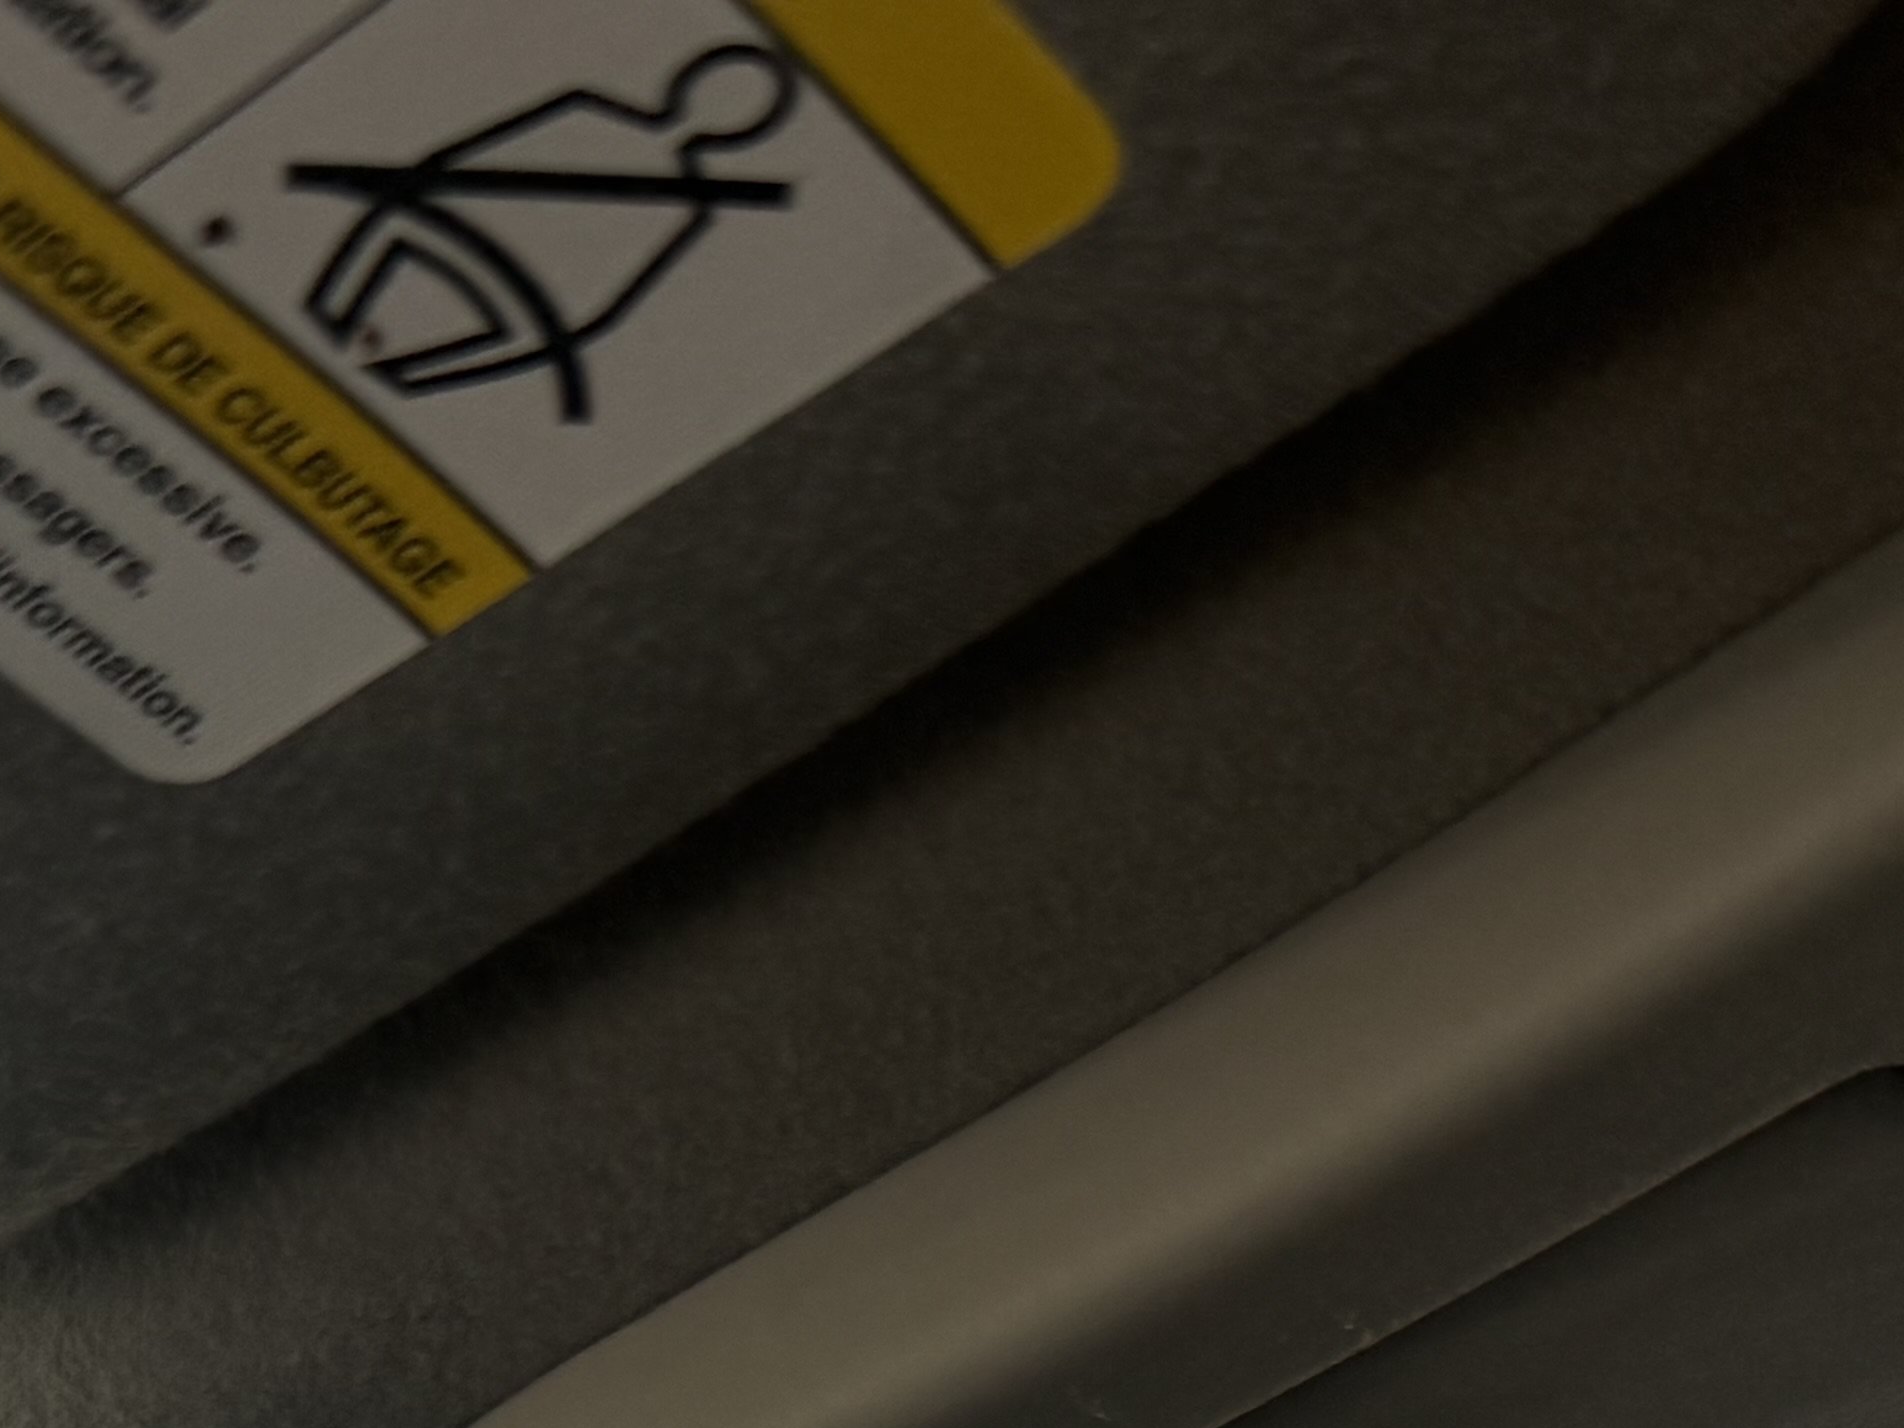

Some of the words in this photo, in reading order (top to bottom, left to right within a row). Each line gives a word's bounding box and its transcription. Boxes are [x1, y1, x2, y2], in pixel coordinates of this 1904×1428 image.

[34, 385, 262, 573] excessive.
[144, 330, 231, 397] DE
[212, 386, 470, 597] CULBUTAGE
